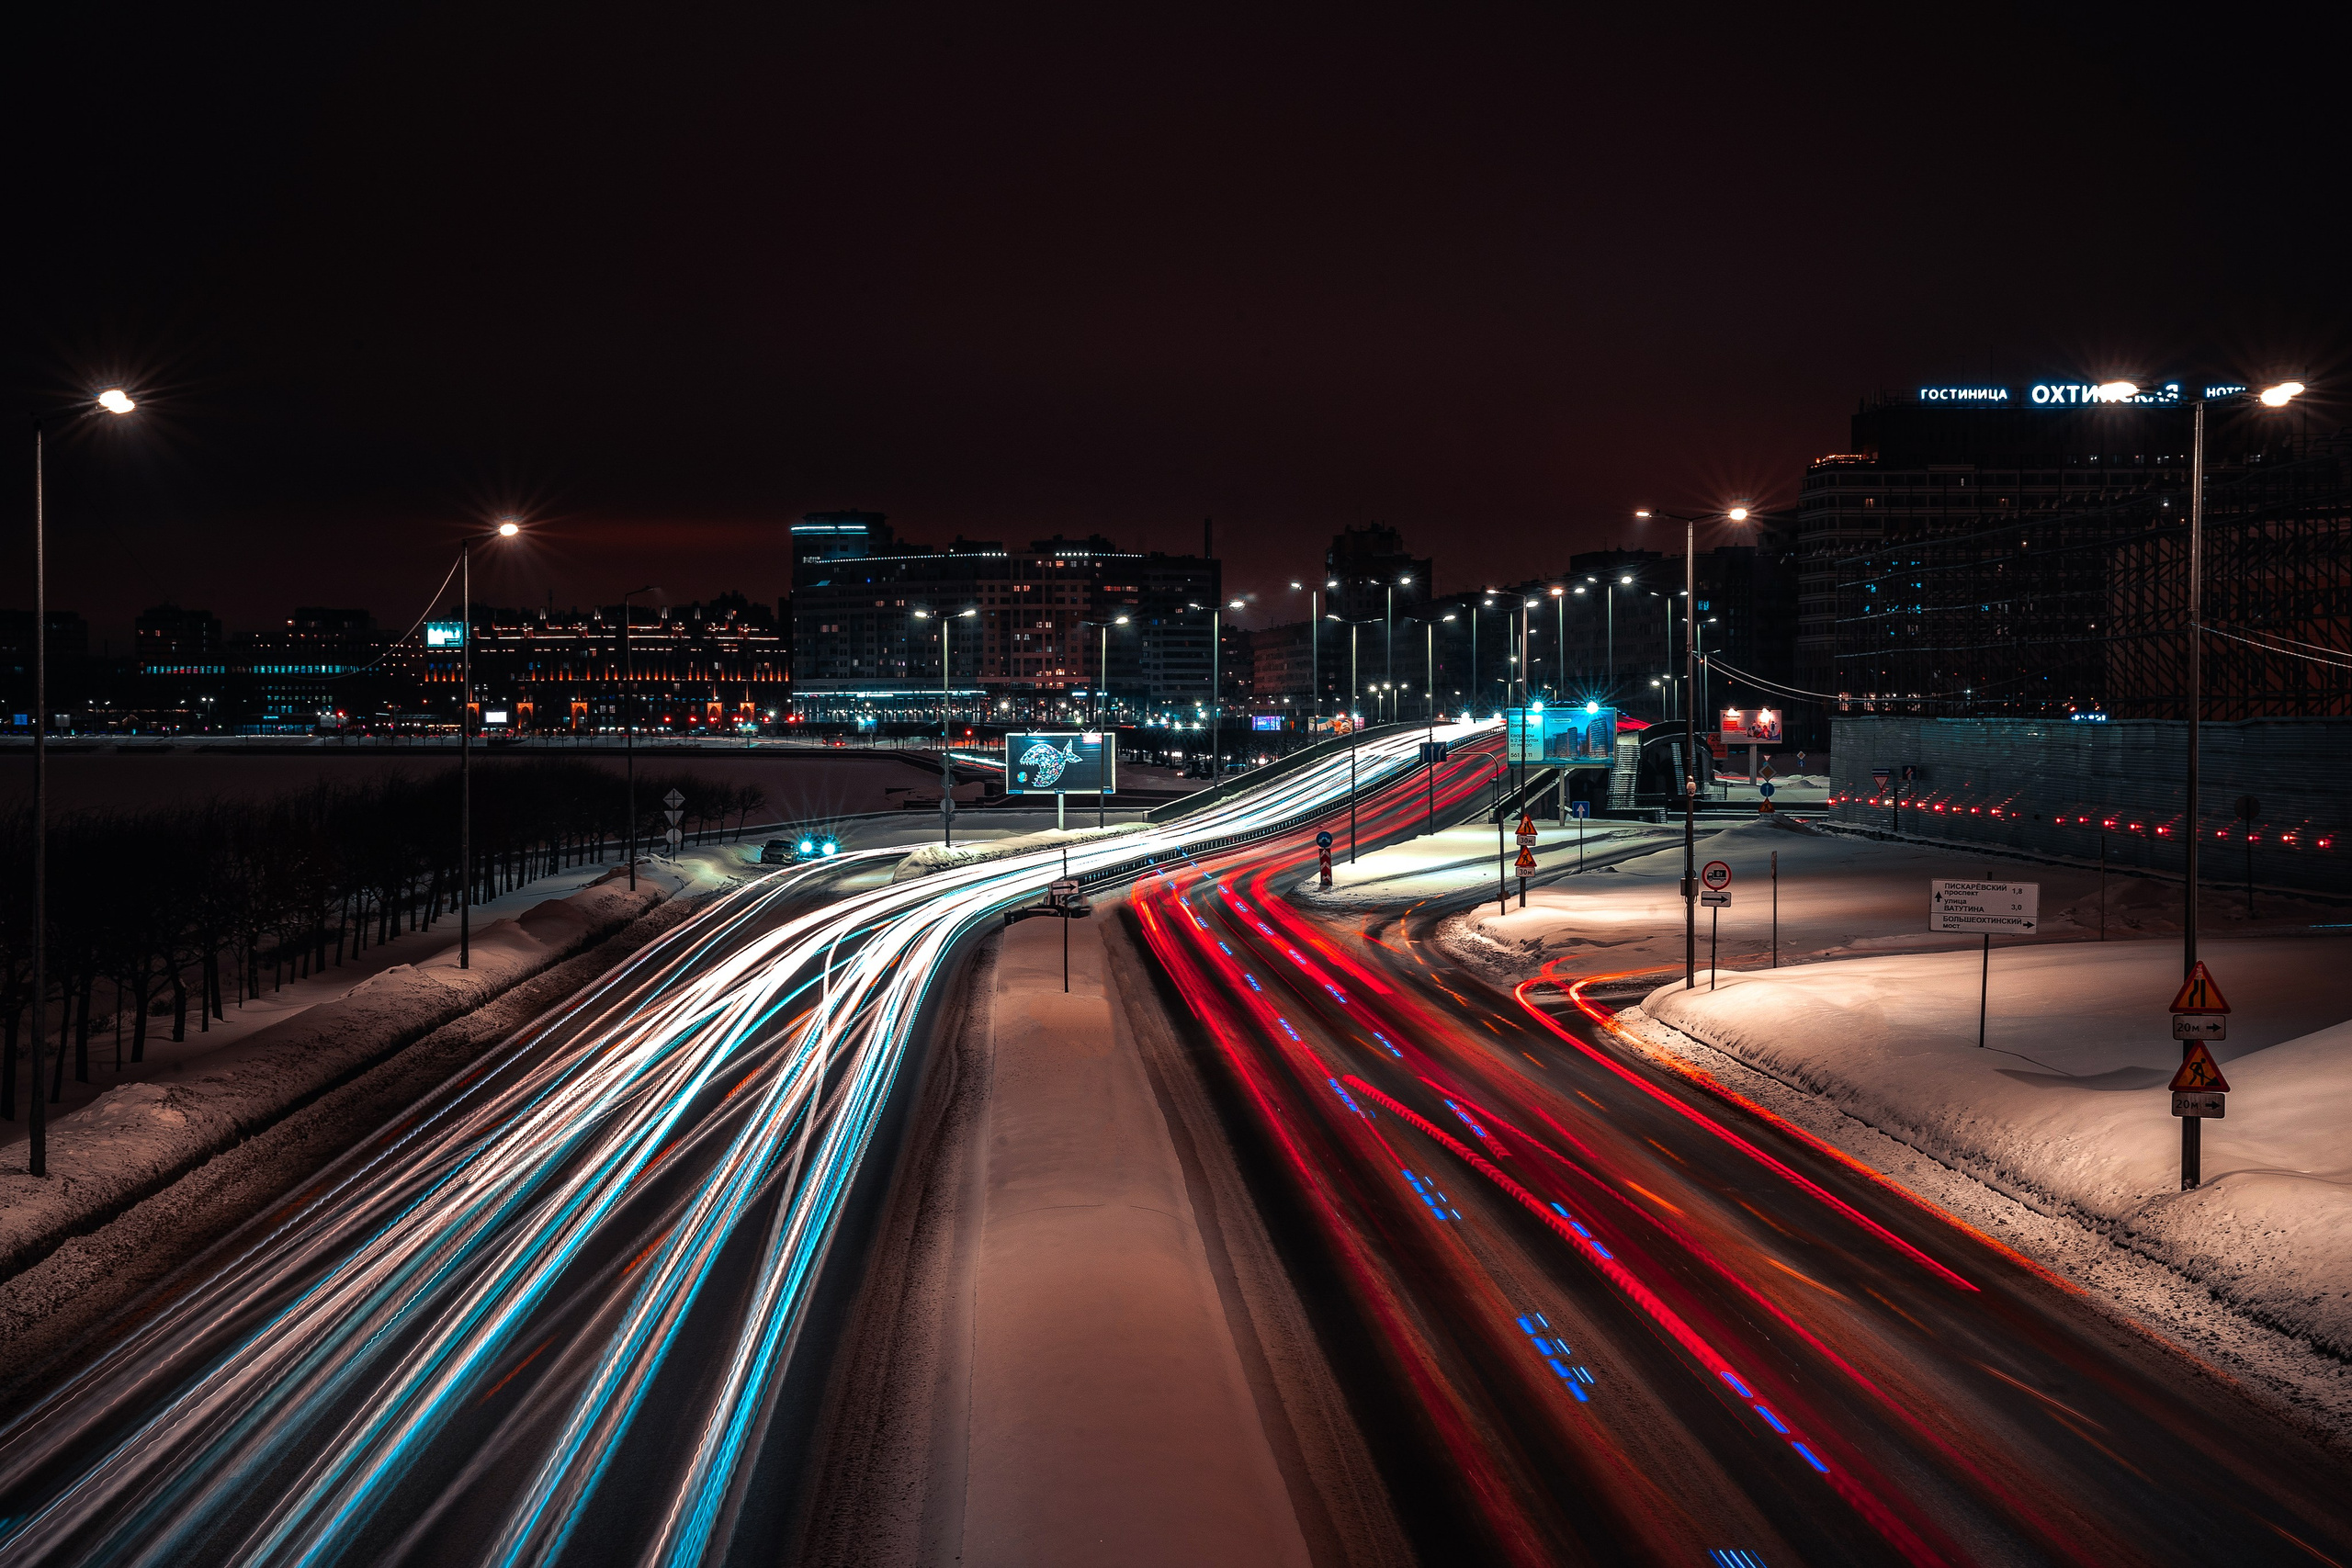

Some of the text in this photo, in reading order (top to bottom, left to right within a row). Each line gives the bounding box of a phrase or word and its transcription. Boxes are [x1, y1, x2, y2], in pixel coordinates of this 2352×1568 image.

[1920, 389, 2007, 401] ГОСТИНИЦА
[1944, 883, 2007, 892] ПИСКАРЁВСКИЙ
[1943, 916, 2022, 925] БОЛЬШЕОХТИНСКИЙ
[2177, 1022, 2200, 1032] 20м
[2176, 1099, 2199, 1110] 20м
